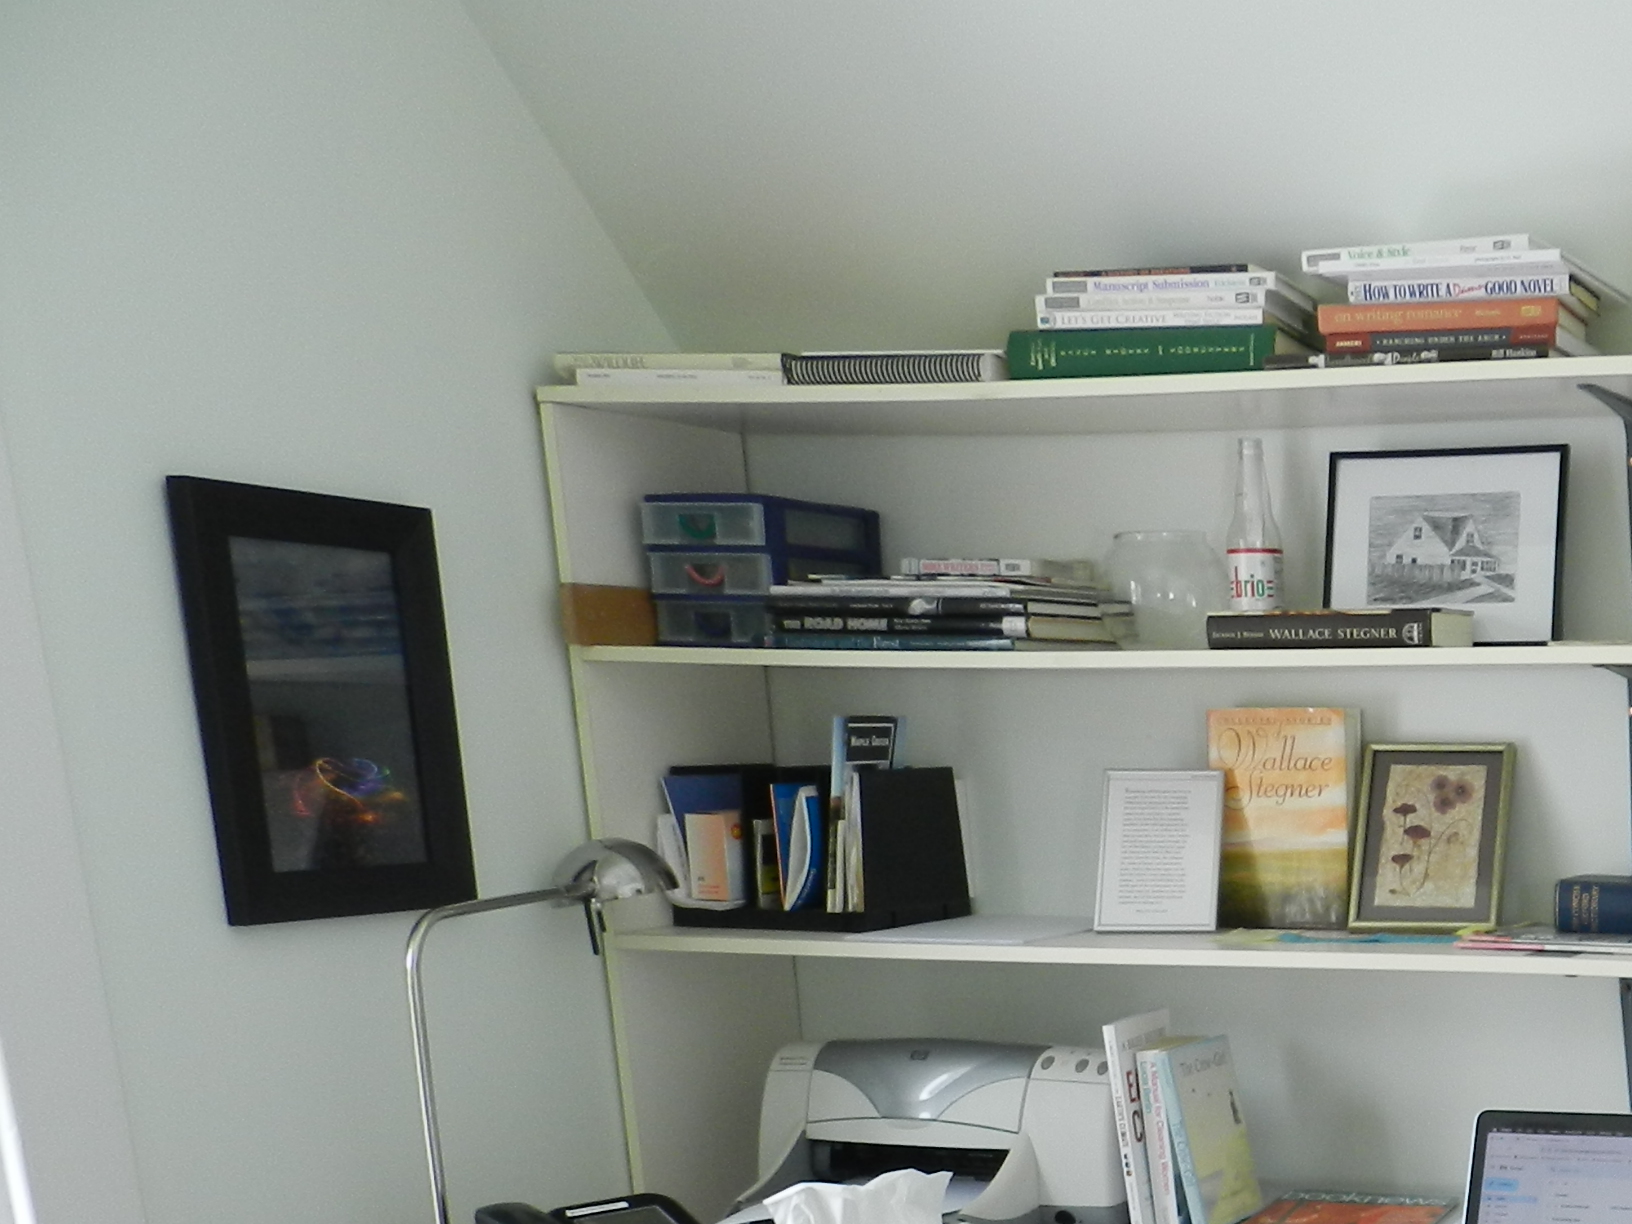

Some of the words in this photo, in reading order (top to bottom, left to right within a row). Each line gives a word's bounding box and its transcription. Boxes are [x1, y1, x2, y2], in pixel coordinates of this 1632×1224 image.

[1093, 279, 1150, 293] Manuscript
[1152, 276, 1211, 290] Submission
[1363, 283, 1390, 301] HOW
[1393, 282, 1407, 300] TO
[1407, 281, 1443, 299] WRITE
[1444, 281, 1453, 298] A
[1485, 279, 1518, 296] GOOD
[1520, 277, 1556, 295] NOVEL
[1061, 313, 1087, 326] LET'S
[1090, 312, 1113, 325] GET
[1115, 311, 1168, 325] CREATIVE
[1334, 311, 1351, 323] on
[1354, 308, 1403, 325] writing
[1406, 307, 1463, 321] romance
[1234, 565, 1265, 598] brio
[803, 617, 844, 631] ROAD
[1269, 627, 1334, 641] WALLACE
[1337, 626, 1399, 640] STEGNER
[1217, 727, 1333, 771] Wallace
[1225, 770, 1330, 811] Stegner
[1151, 1070, 1161, 1104] Manual
